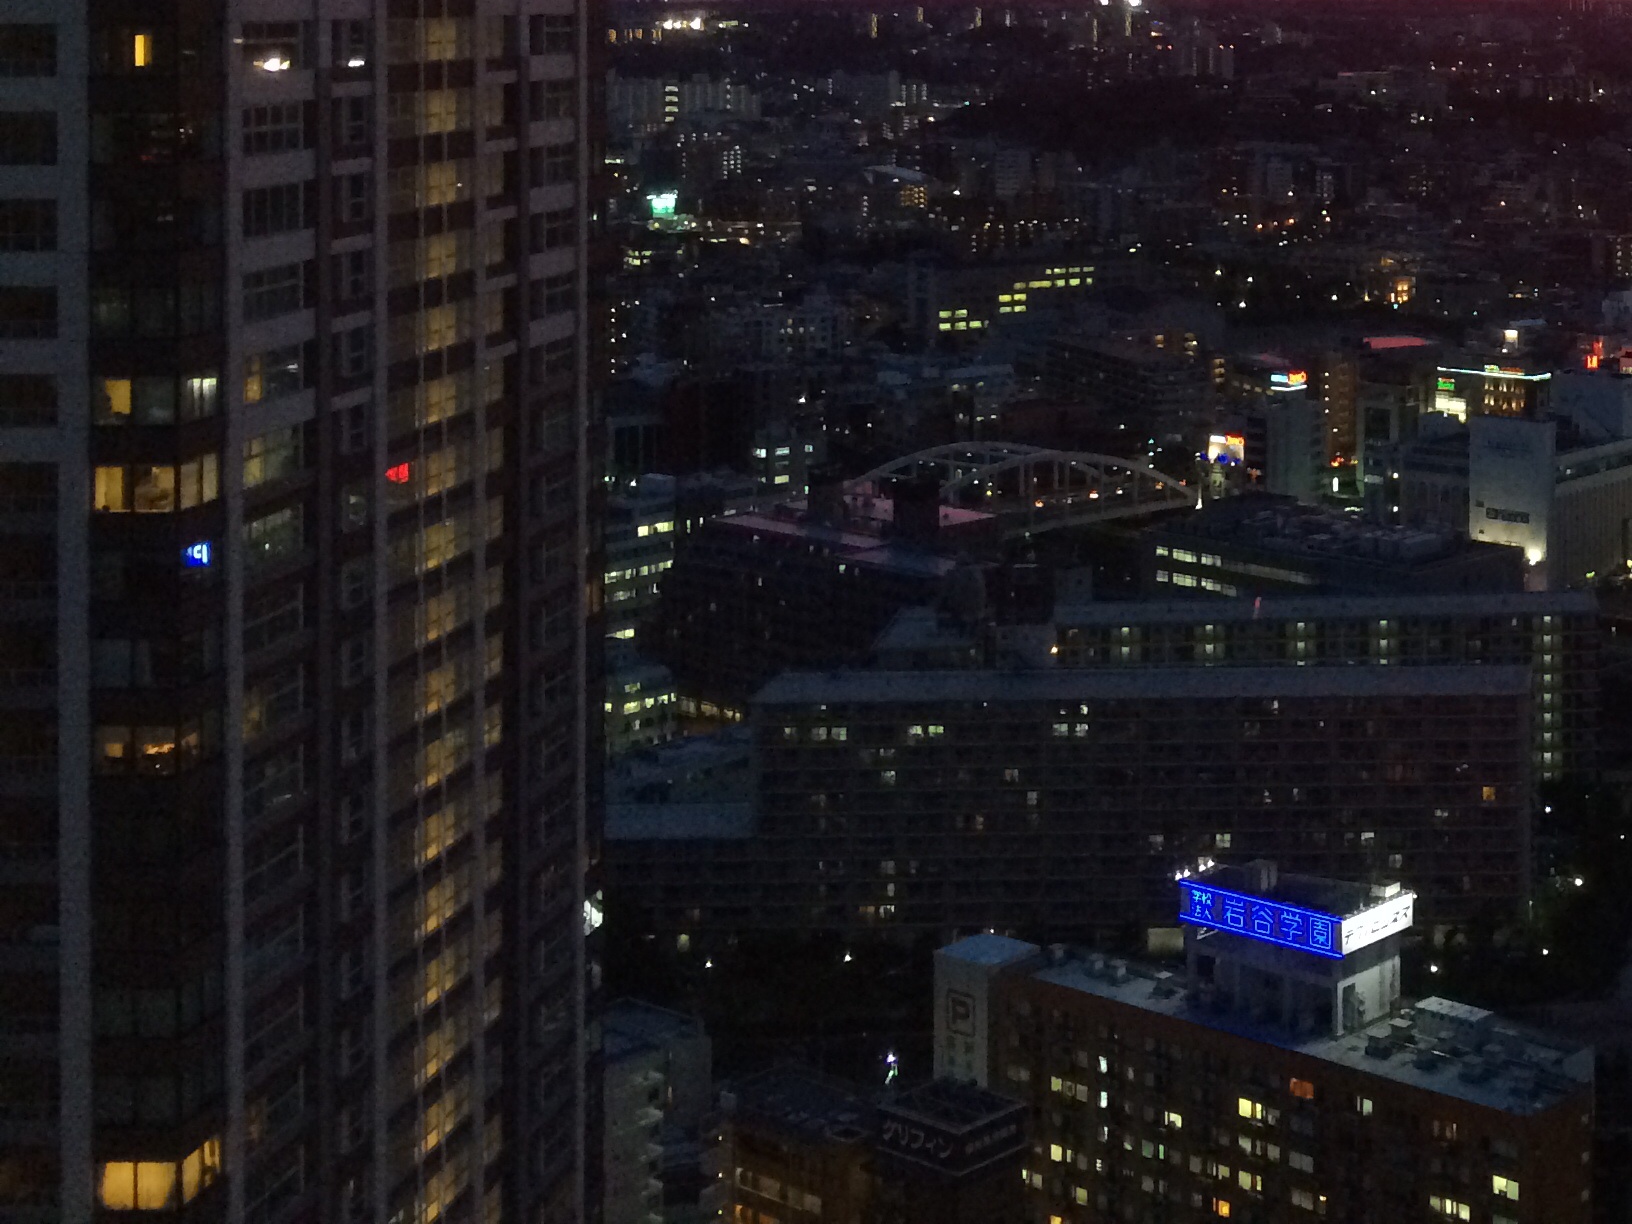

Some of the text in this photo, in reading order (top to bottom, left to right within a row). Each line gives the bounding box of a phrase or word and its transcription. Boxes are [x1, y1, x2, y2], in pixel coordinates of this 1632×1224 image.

[1223, 897, 1332, 951] 岩谷学園
[952, 996, 970, 1024] P
